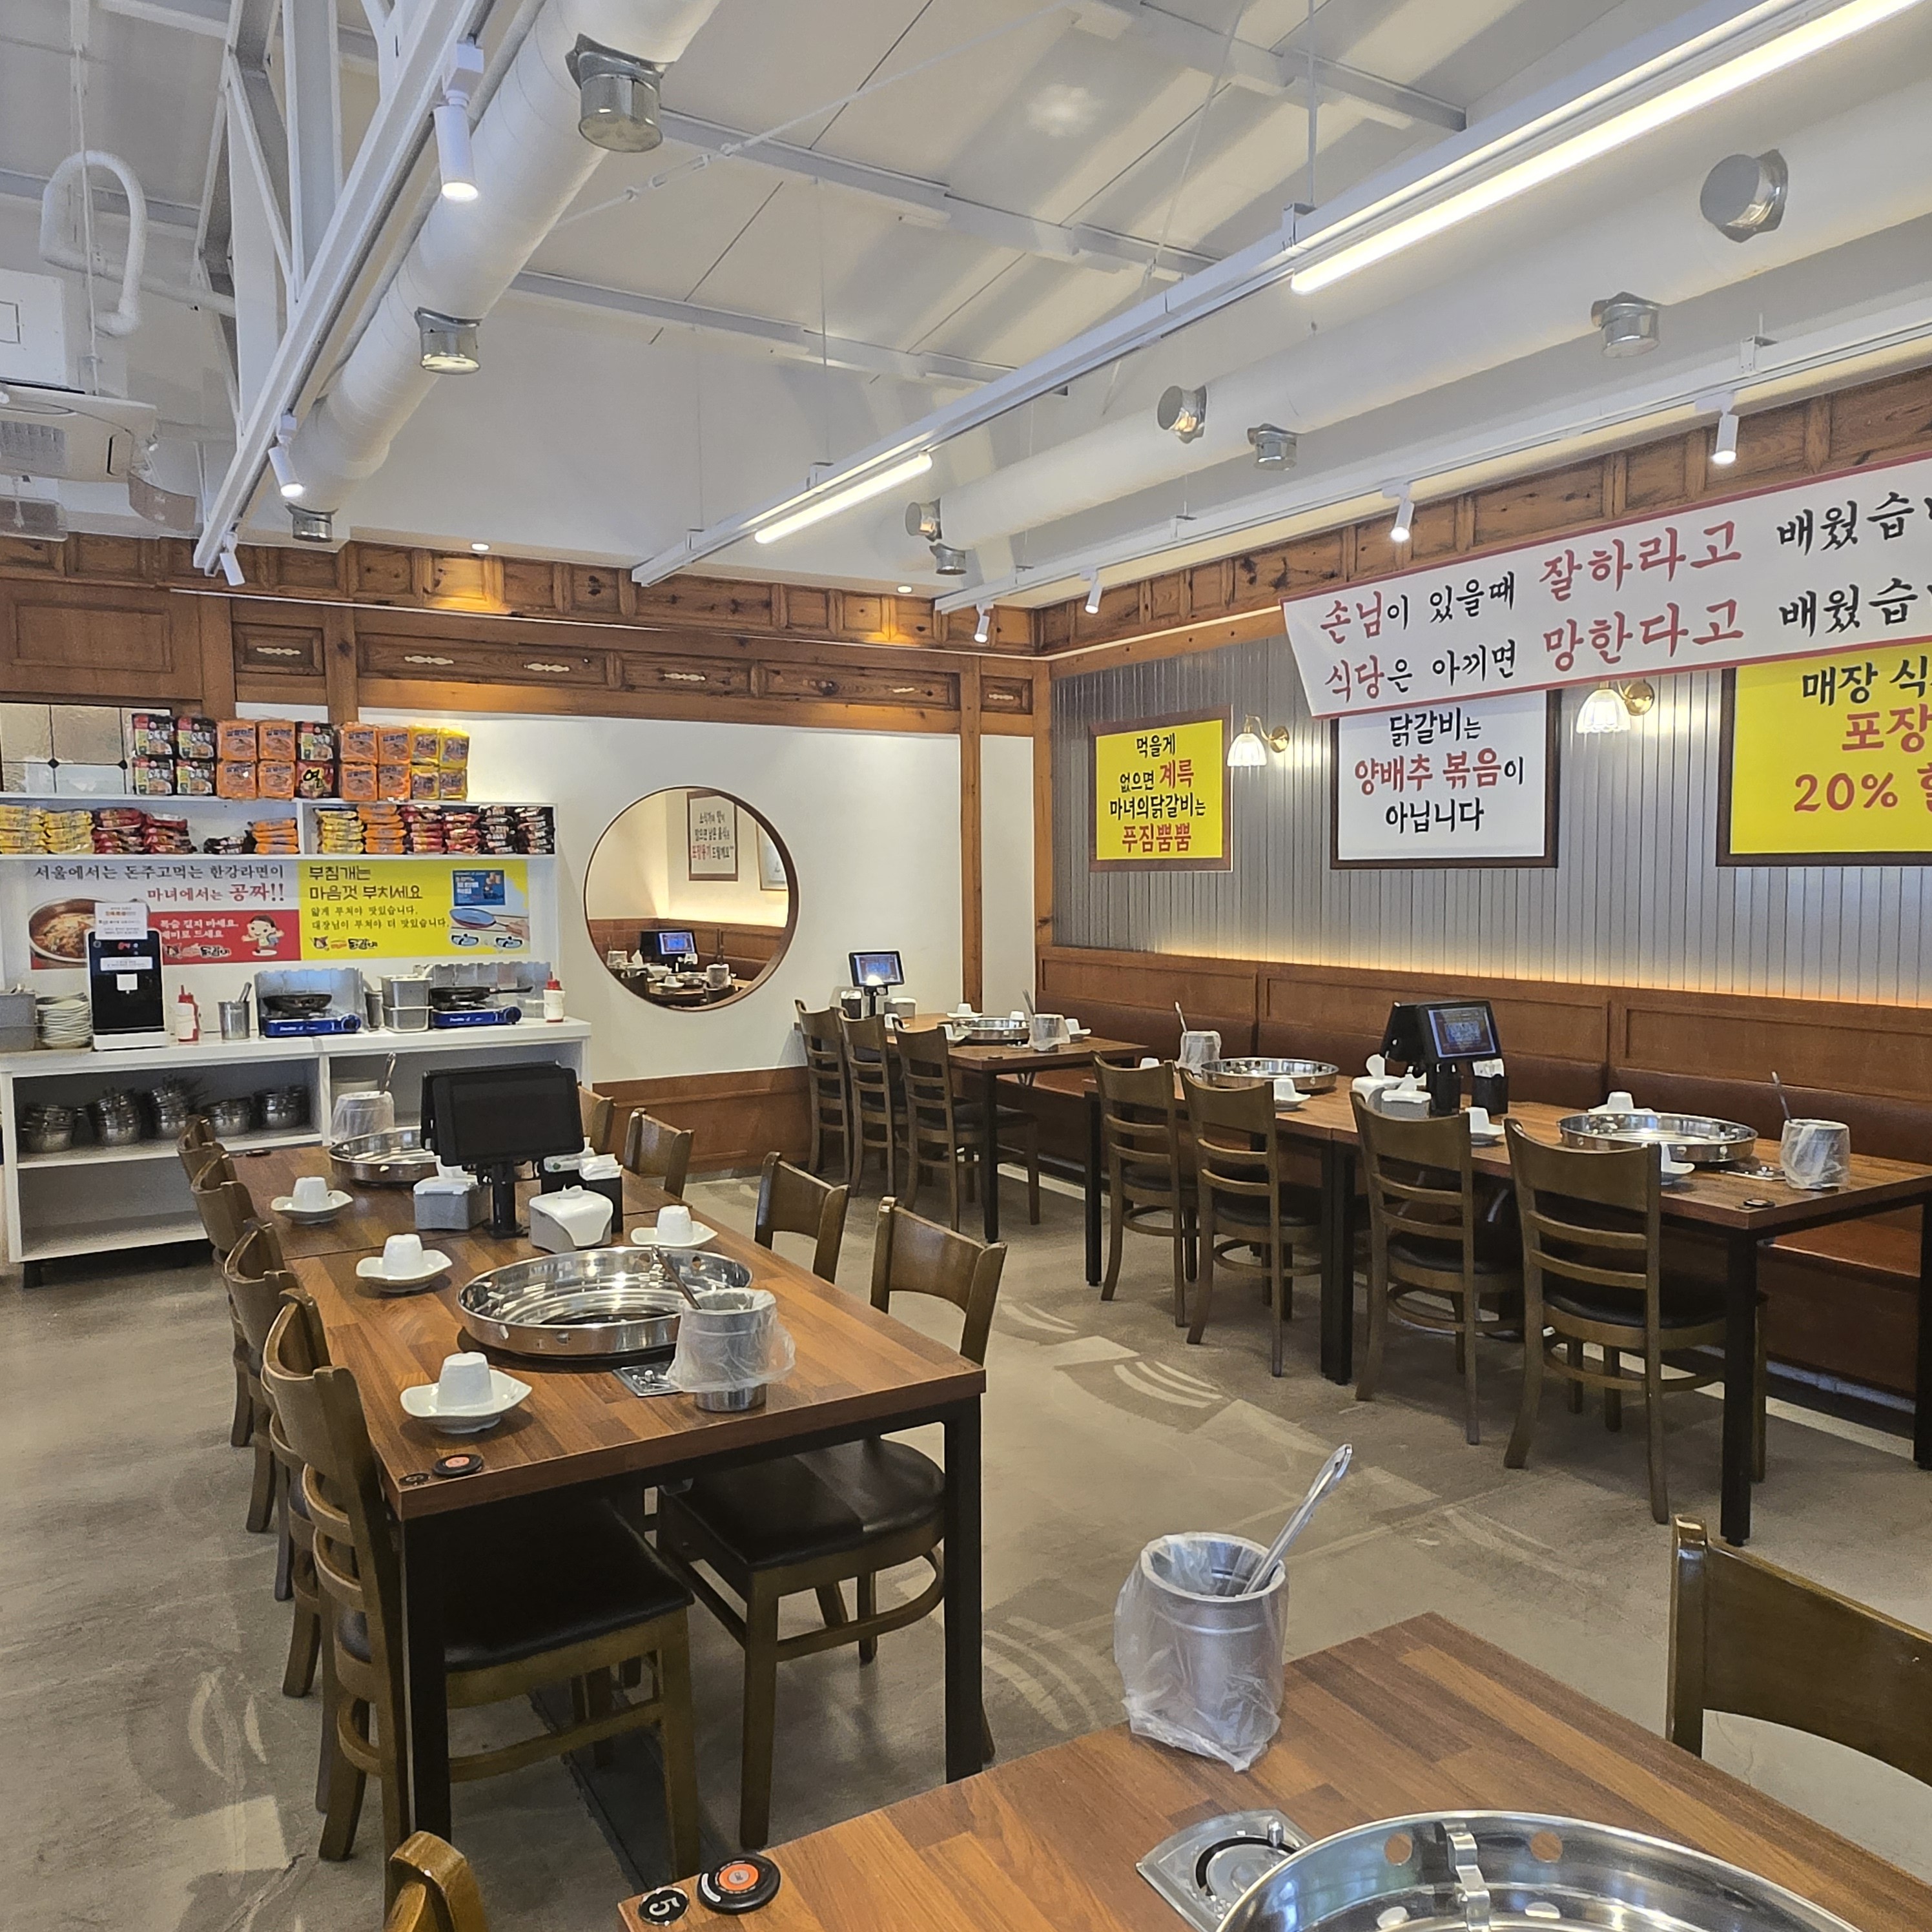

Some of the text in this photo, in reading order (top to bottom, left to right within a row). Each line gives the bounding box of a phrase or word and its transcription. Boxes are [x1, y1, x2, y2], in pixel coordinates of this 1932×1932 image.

[1319, 491, 1932, 644] 손님이 있을때 잘하라고 배웠습
[1324, 578, 1932, 703] 식당은 아끼면 망한다고 배웠습
[1802, 655, 1932, 706] 매장 식
[1389, 708, 1482, 746] 닭갈비는
[1136, 732, 1176, 758] 먹을게
[1120, 759, 1195, 793] 없으면 계륵
[1354, 746, 1525, 796] 양배추 볶음이
[1109, 792, 1206, 820] 마녀의닭갈비는
[1793, 771, 1899, 813] 20%
[1384, 796, 1485, 834] 아닙니다
[1122, 823, 1191, 853] 푸짐뿜뿜
[35, 864, 284, 880] 서울에서는 돈주고먹는 한강라면이
[309, 866, 371, 881] 부침개는
[147, 883, 285, 902] 마녀에서는 공짜!!
[310, 885, 423, 900] 마음껏 부치세요
[368, 905, 418, 916] 맛있습니다.
[401, 917, 450, 929] 맛있습니다.
[648, 1896, 681, 1916] 5
